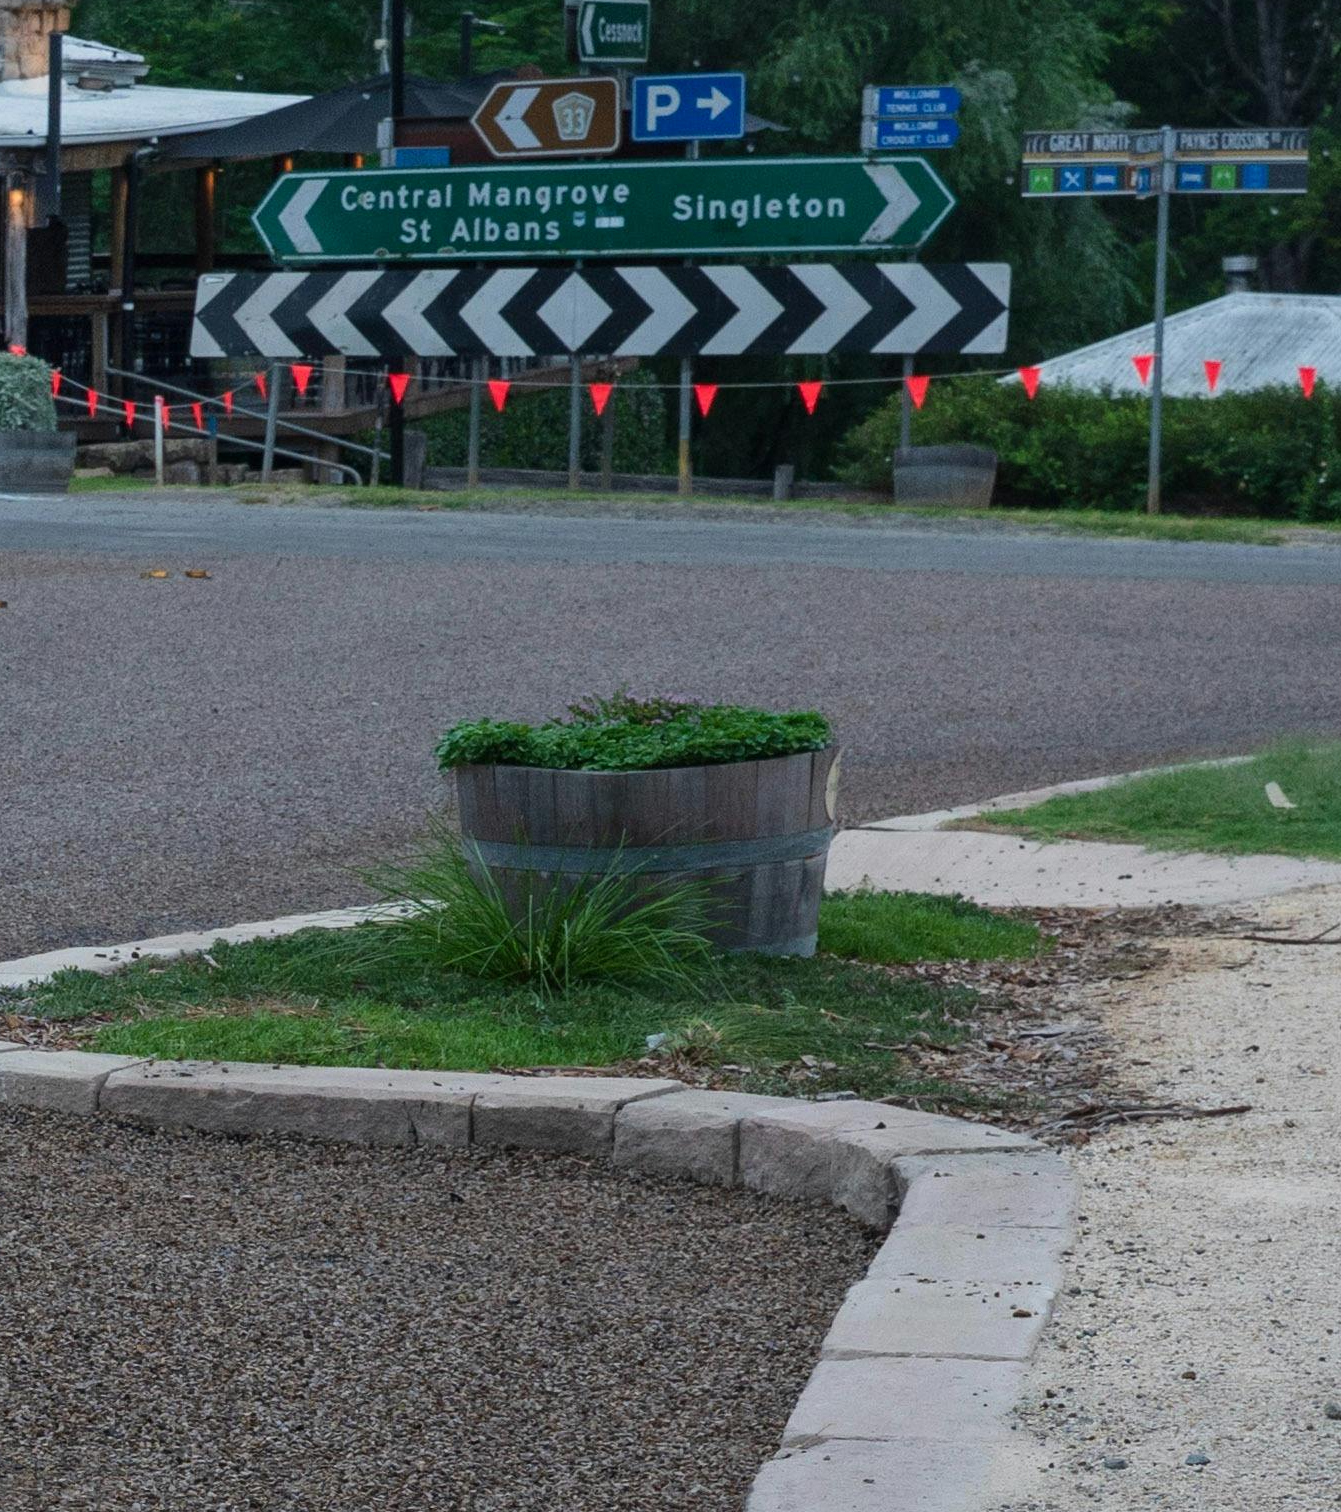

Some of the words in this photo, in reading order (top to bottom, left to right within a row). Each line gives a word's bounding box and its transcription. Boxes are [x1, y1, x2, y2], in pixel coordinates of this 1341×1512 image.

[562, 107, 586, 134] 33
[646, 85, 681, 132] P
[921, 103, 947, 112] CLUB
[925, 134, 950, 144] CLUB
[1049, 134, 1089, 152] GREAT
[340, 184, 453, 211] Central
[468, 182, 631, 214] Mangrove
[672, 192, 846, 228] Singleton
[400, 217, 432, 244] St
[450, 217, 560, 243] Albans
